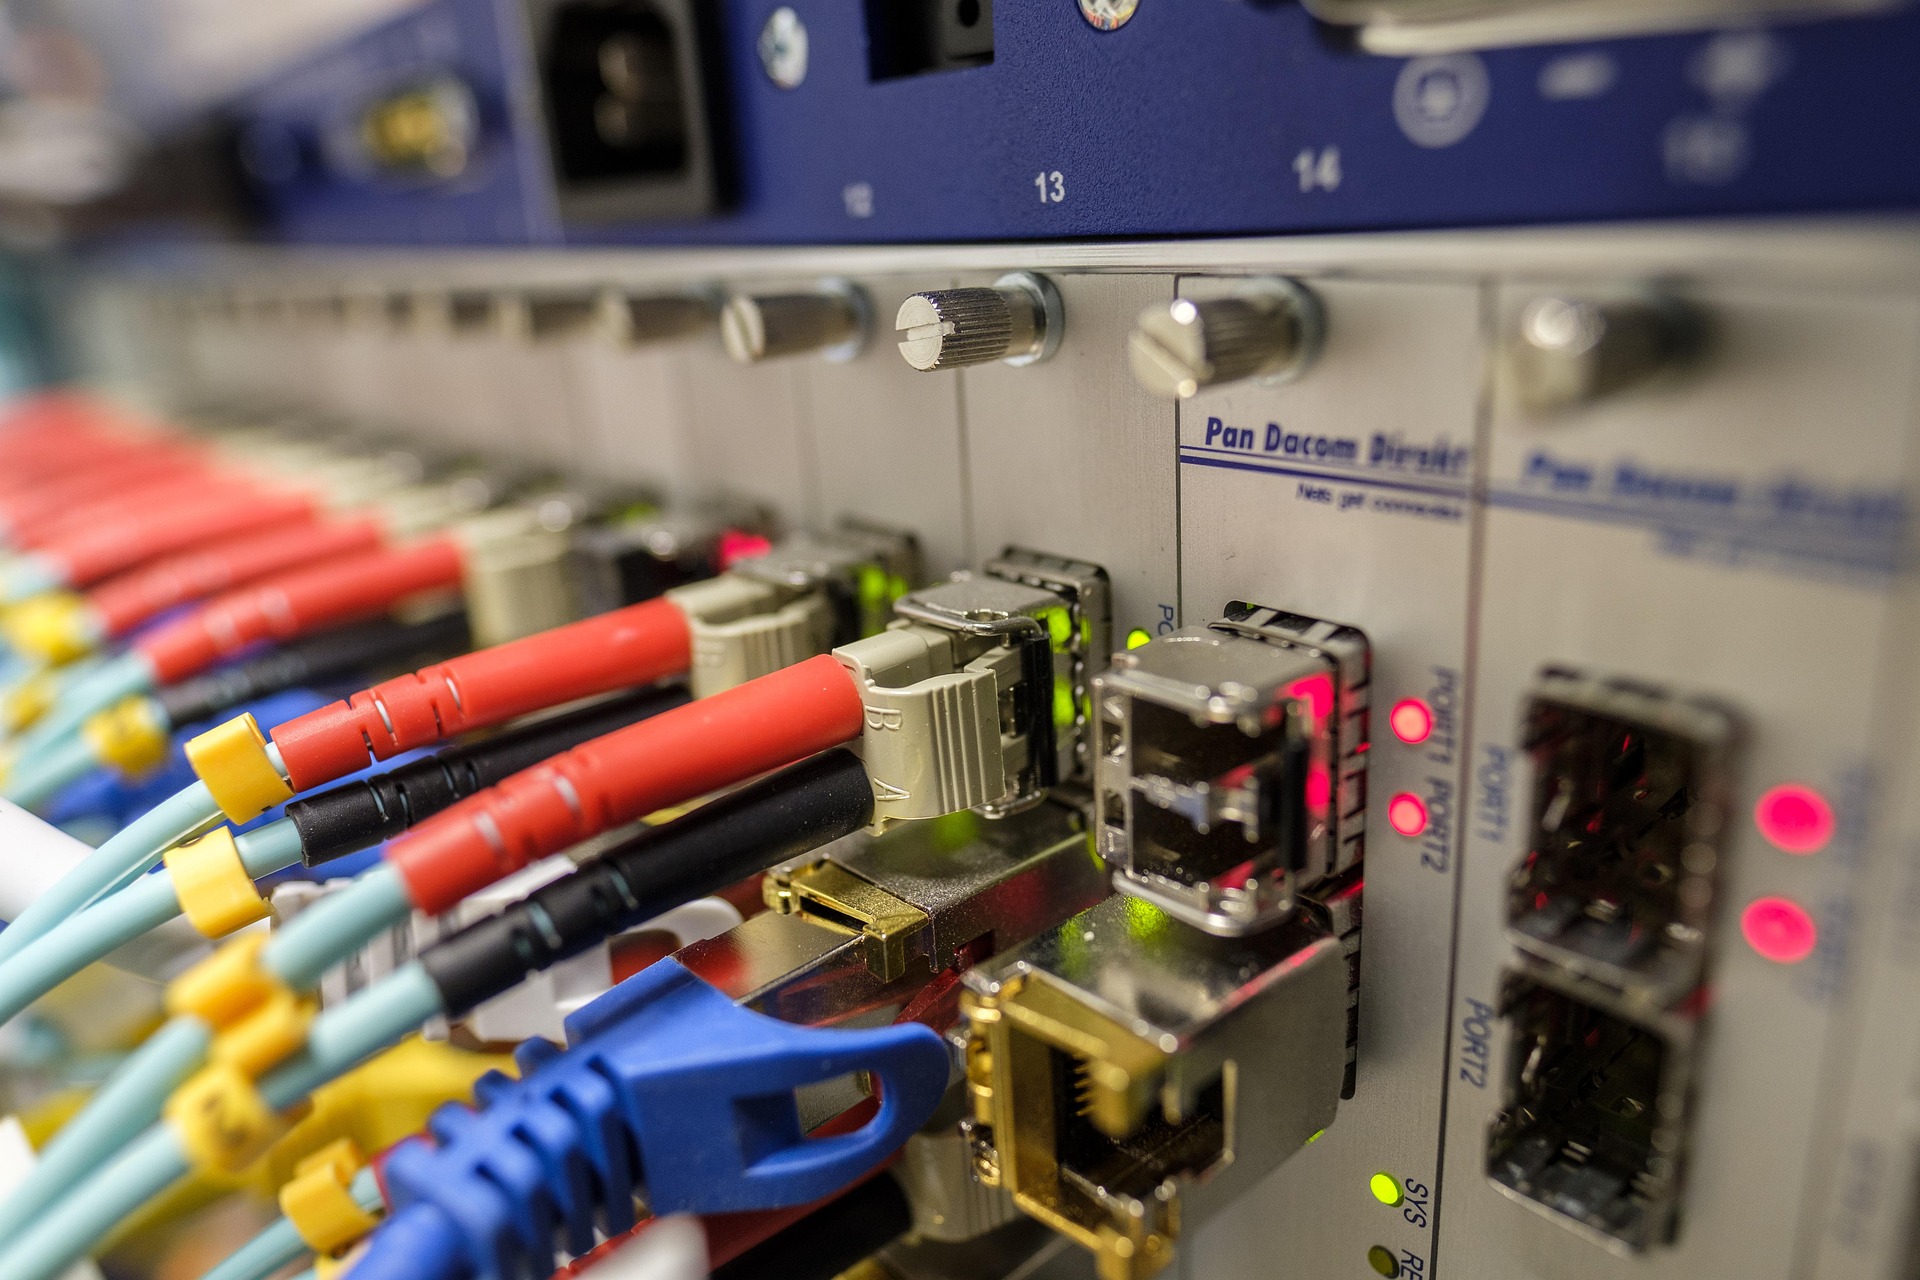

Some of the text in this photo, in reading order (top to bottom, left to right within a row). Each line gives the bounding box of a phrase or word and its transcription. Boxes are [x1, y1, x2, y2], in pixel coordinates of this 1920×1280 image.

[1034, 170, 1066, 204] 13
[1293, 149, 1342, 193] 14
[1205, 416, 1254, 449] Pan
[1264, 423, 1356, 459] Dacom
[1158, 604, 1174, 636] PO
[864, 705, 902, 731] B
[1428, 665, 1458, 765] PORT1
[873, 777, 911, 801] A
[1476, 742, 1514, 843] PORT1
[1420, 775, 1454, 874] PORT2
[1460, 996, 1494, 1089] PORT2
[1403, 1178, 1428, 1228] SYS
